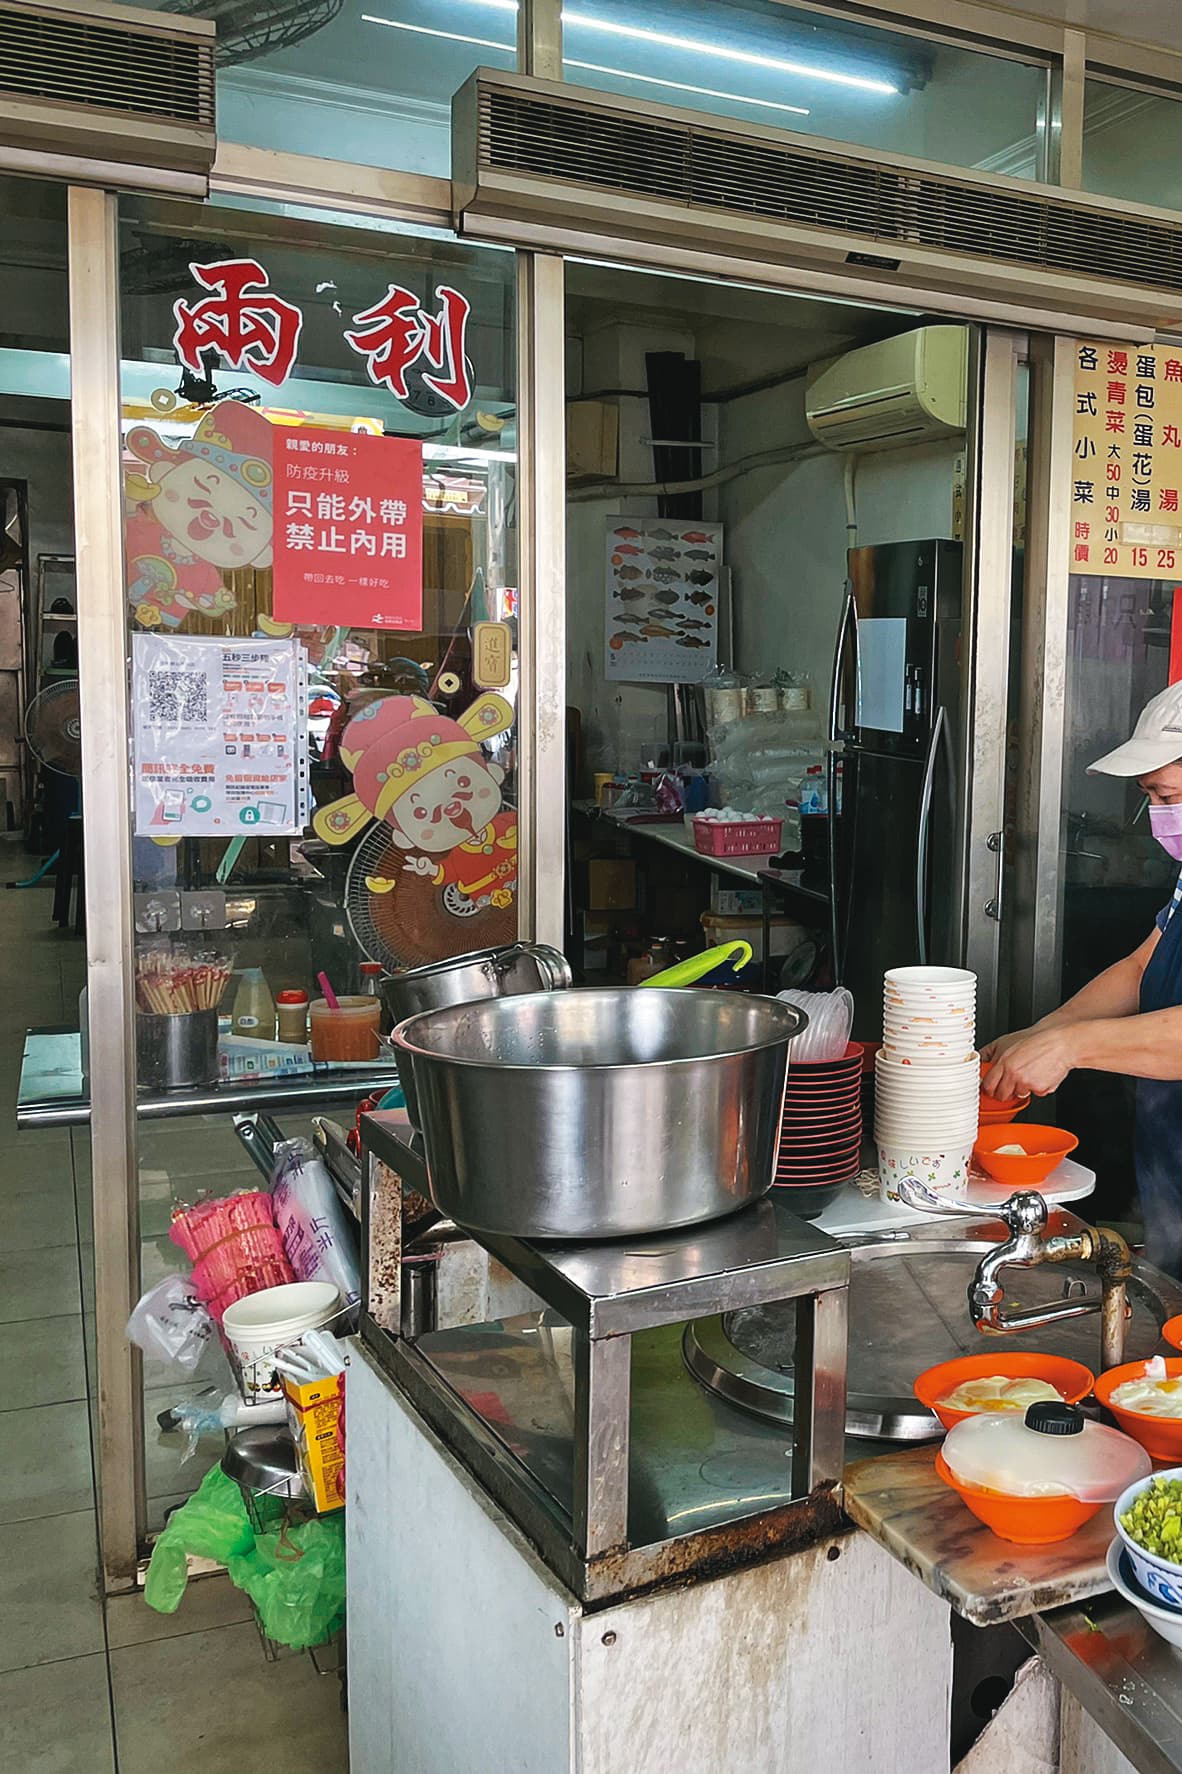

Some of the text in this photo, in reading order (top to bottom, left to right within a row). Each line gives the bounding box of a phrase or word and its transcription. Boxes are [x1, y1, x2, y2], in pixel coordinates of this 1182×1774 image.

[1074, 346, 1099, 562] 各式小菜 時價
[1104, 351, 1128, 564] 燙青菜 大 50 中 30 小 20
[286, 463, 350, 484] 防疫升級
[286, 490, 407, 526] 只能外帶
[286, 522, 407, 559] 禁止內用
[1132, 548, 1147, 566] 15
[1157, 550, 1175, 569] 25
